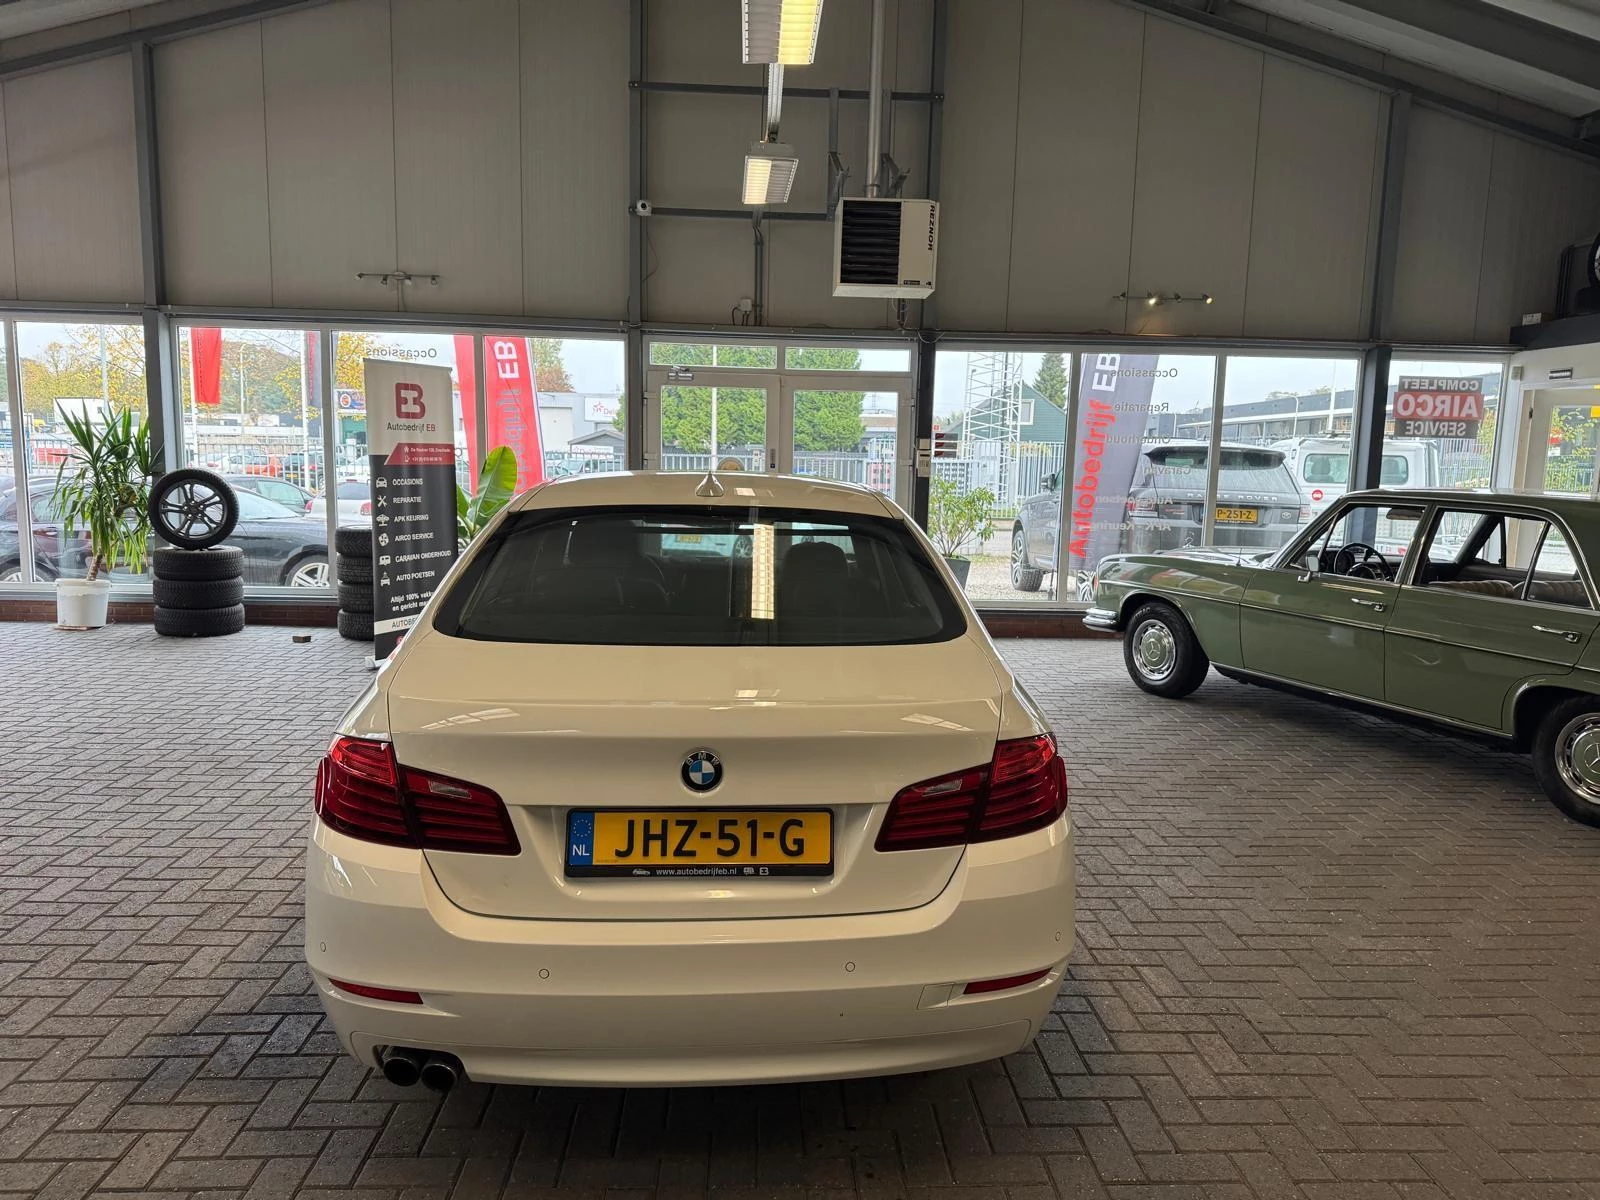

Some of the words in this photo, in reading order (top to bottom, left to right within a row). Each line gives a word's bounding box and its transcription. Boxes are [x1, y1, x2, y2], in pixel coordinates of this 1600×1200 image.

[927, 205, 936, 251] REZNOR
[387, 422, 425, 433] Autobedrijf
[426, 423, 436, 432] EB
[1067, 399, 1117, 559] Autobedrijf
[1092, 354, 1120, 392] EB
[392, 478, 423, 486] OCCASIONS
[392, 496, 422, 504] REPARATIE
[393, 515, 405, 523] APK
[406, 514, 429, 522] KEURING
[412, 532, 434, 540] SERVICE
[395, 553, 420, 563] CARAVAN
[420, 550, 452, 560] ONDERHOUD
[396, 573, 411, 582] AUTO
[411, 570, 435, 579] POETSEN
[405, 592, 420, 601] 100%
[400, 601, 418, 612] gericht
[685, 752, 720, 766] BMW
[572, 844, 590, 856] NL
[614, 818, 805, 858] JHZ-51-G
[655, 866, 738, 876] www.autobedrijfeb.nl
